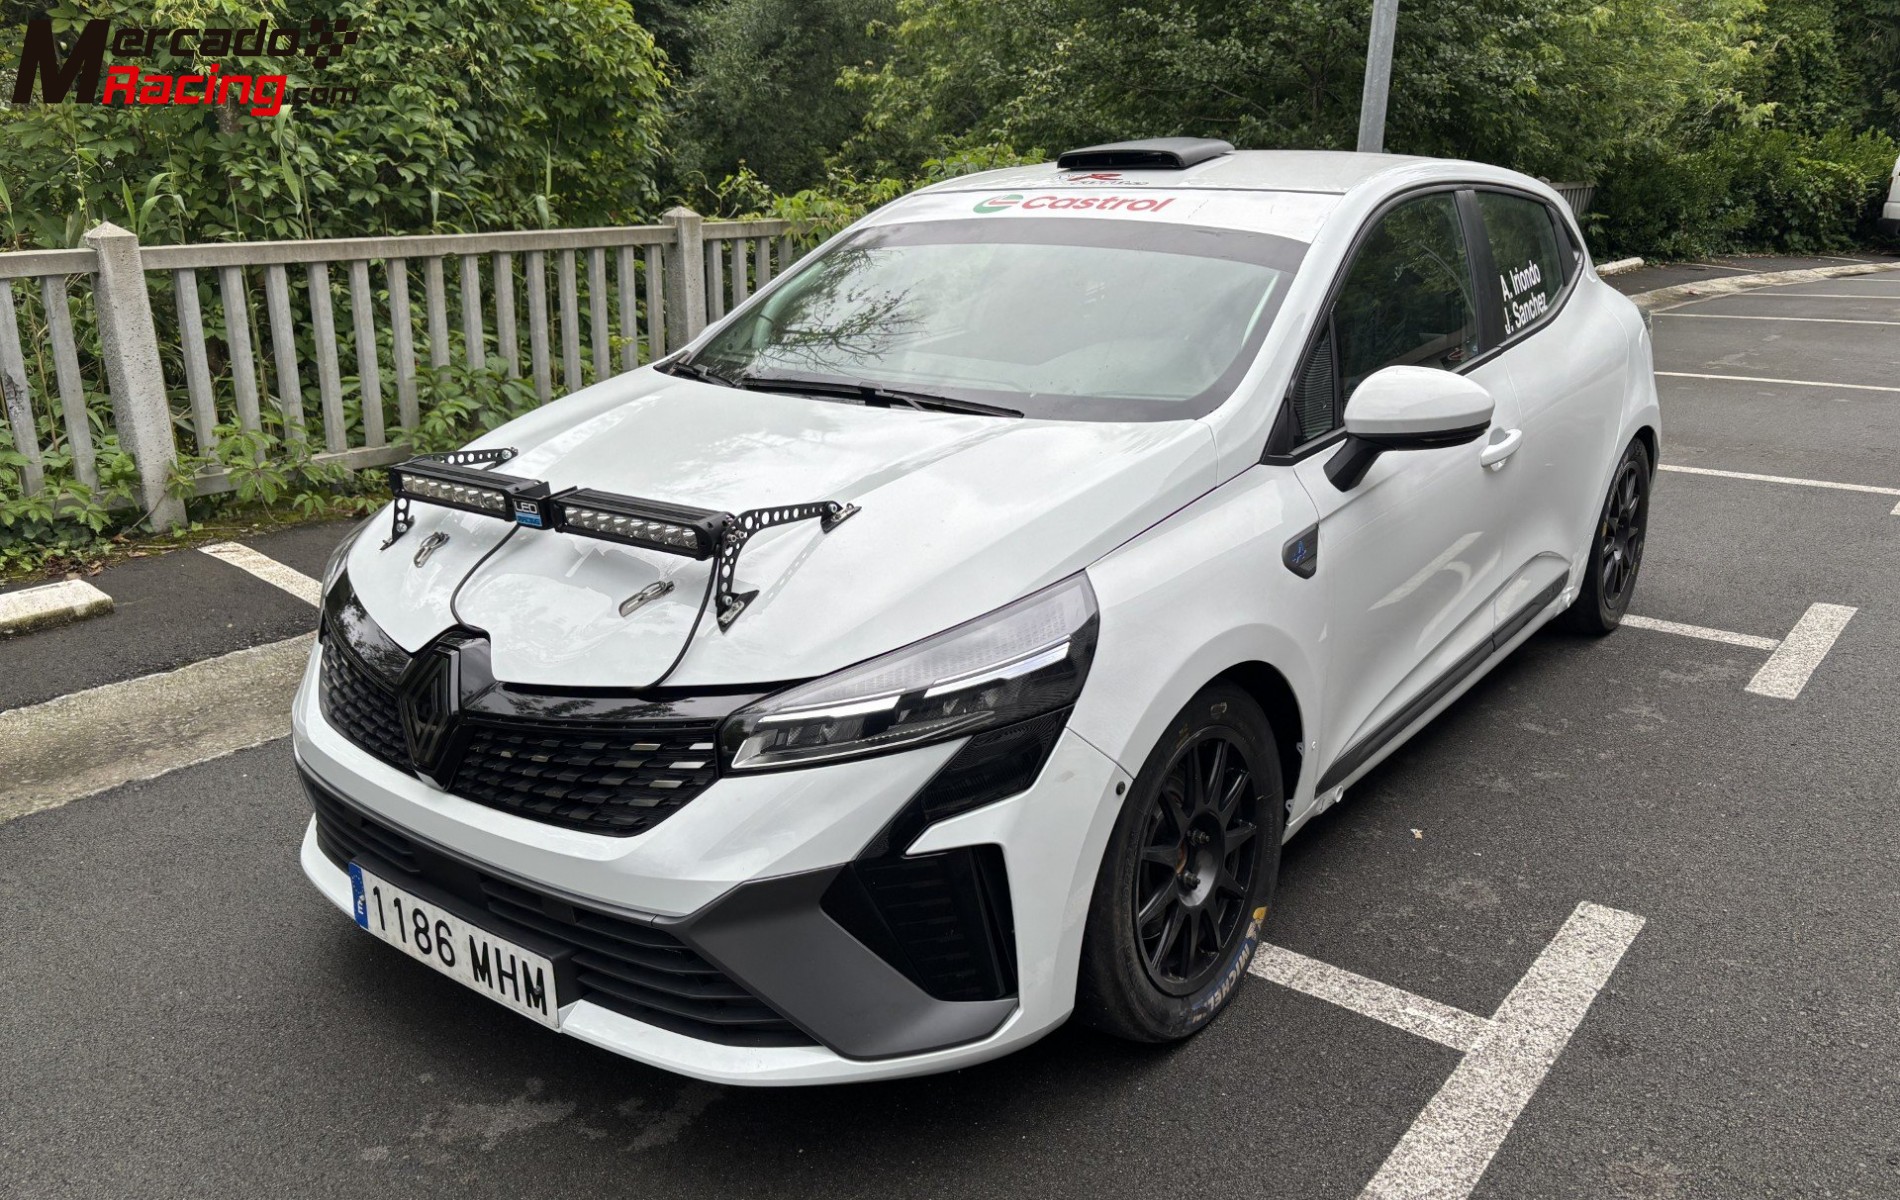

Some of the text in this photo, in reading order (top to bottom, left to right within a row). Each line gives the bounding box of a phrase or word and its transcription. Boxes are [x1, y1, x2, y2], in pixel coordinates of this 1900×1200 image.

[1022, 197, 1176, 212] Castrol
[1500, 260, 1541, 301] A. Iriondo
[1505, 292, 1548, 334] J. Sanchez
[373, 886, 547, 1016] 1186 MHM
